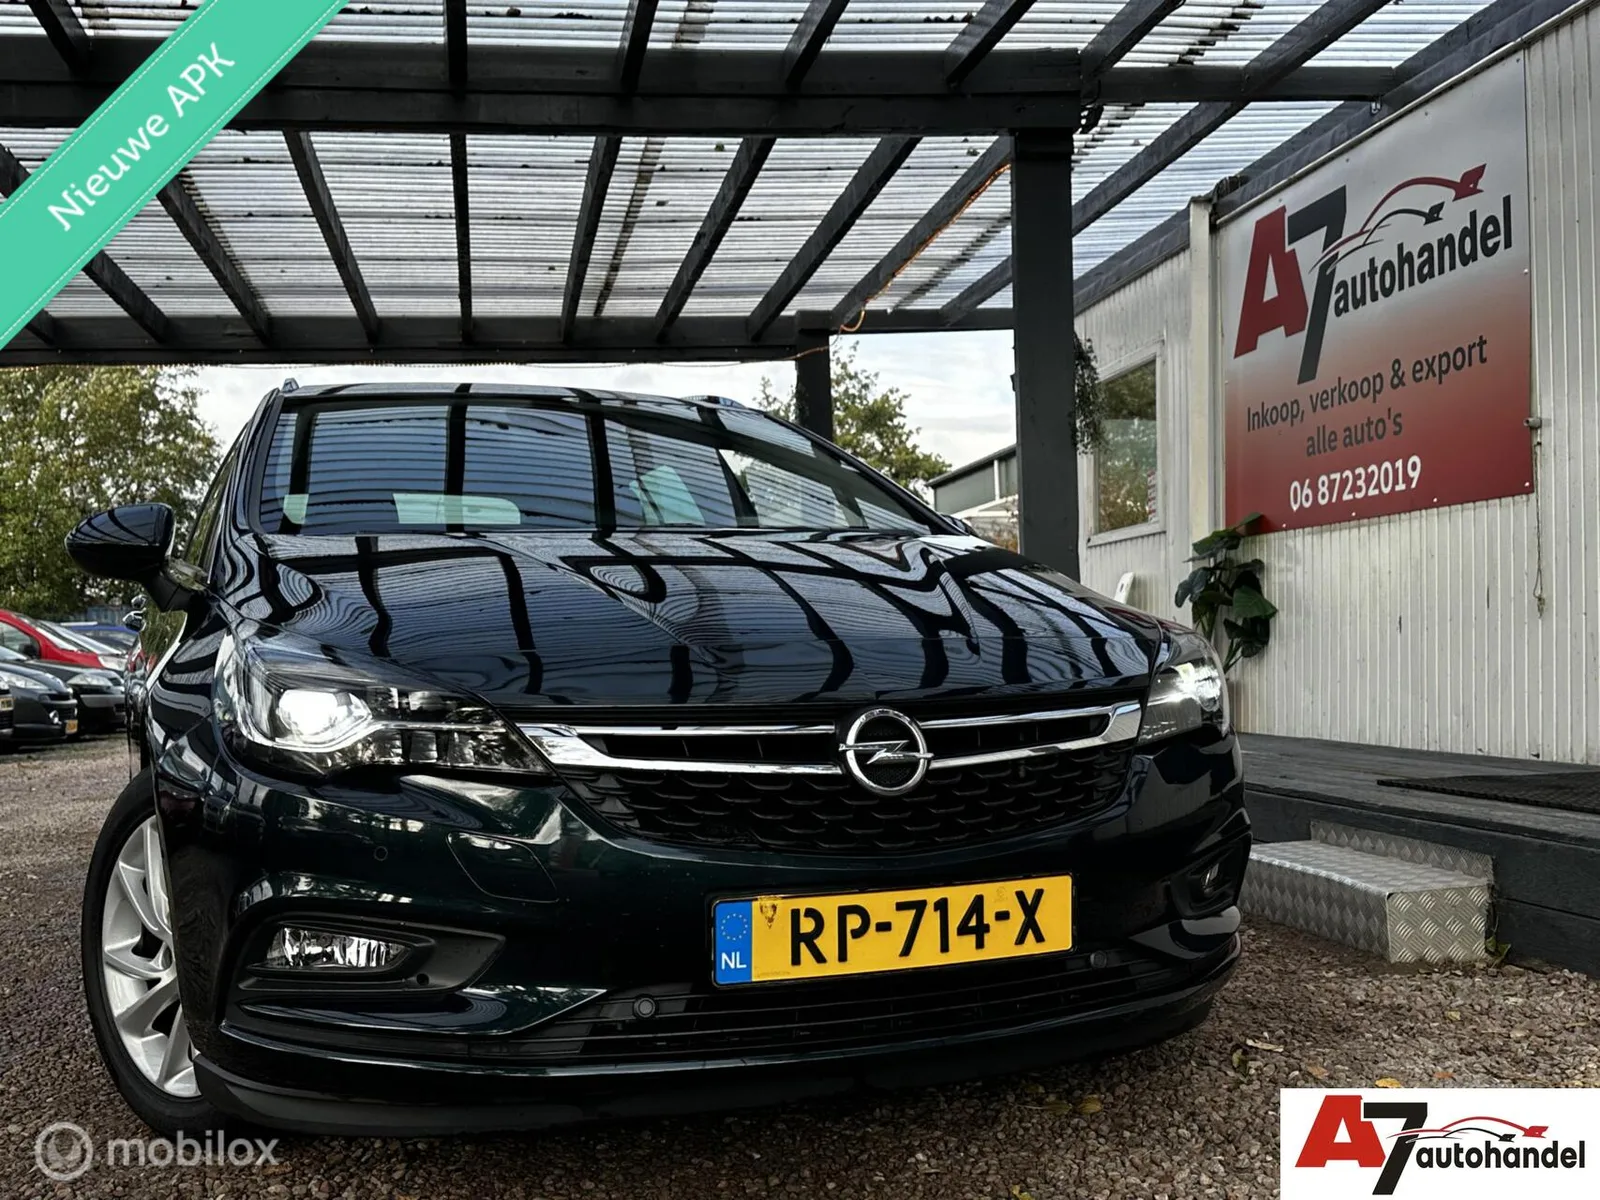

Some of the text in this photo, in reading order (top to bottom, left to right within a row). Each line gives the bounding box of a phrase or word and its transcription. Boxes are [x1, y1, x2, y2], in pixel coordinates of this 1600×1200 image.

[1233, 184, 1347, 385] A7
[1333, 194, 1513, 318] autohandel
[1246, 335, 1488, 433] Inkoop, verkoop & export
[1306, 407, 1403, 458] alle auto's
[1289, 455, 1422, 512] 06 87232019
[721, 952, 747, 970] NL
[790, 888, 1046, 966] RP-714-X
